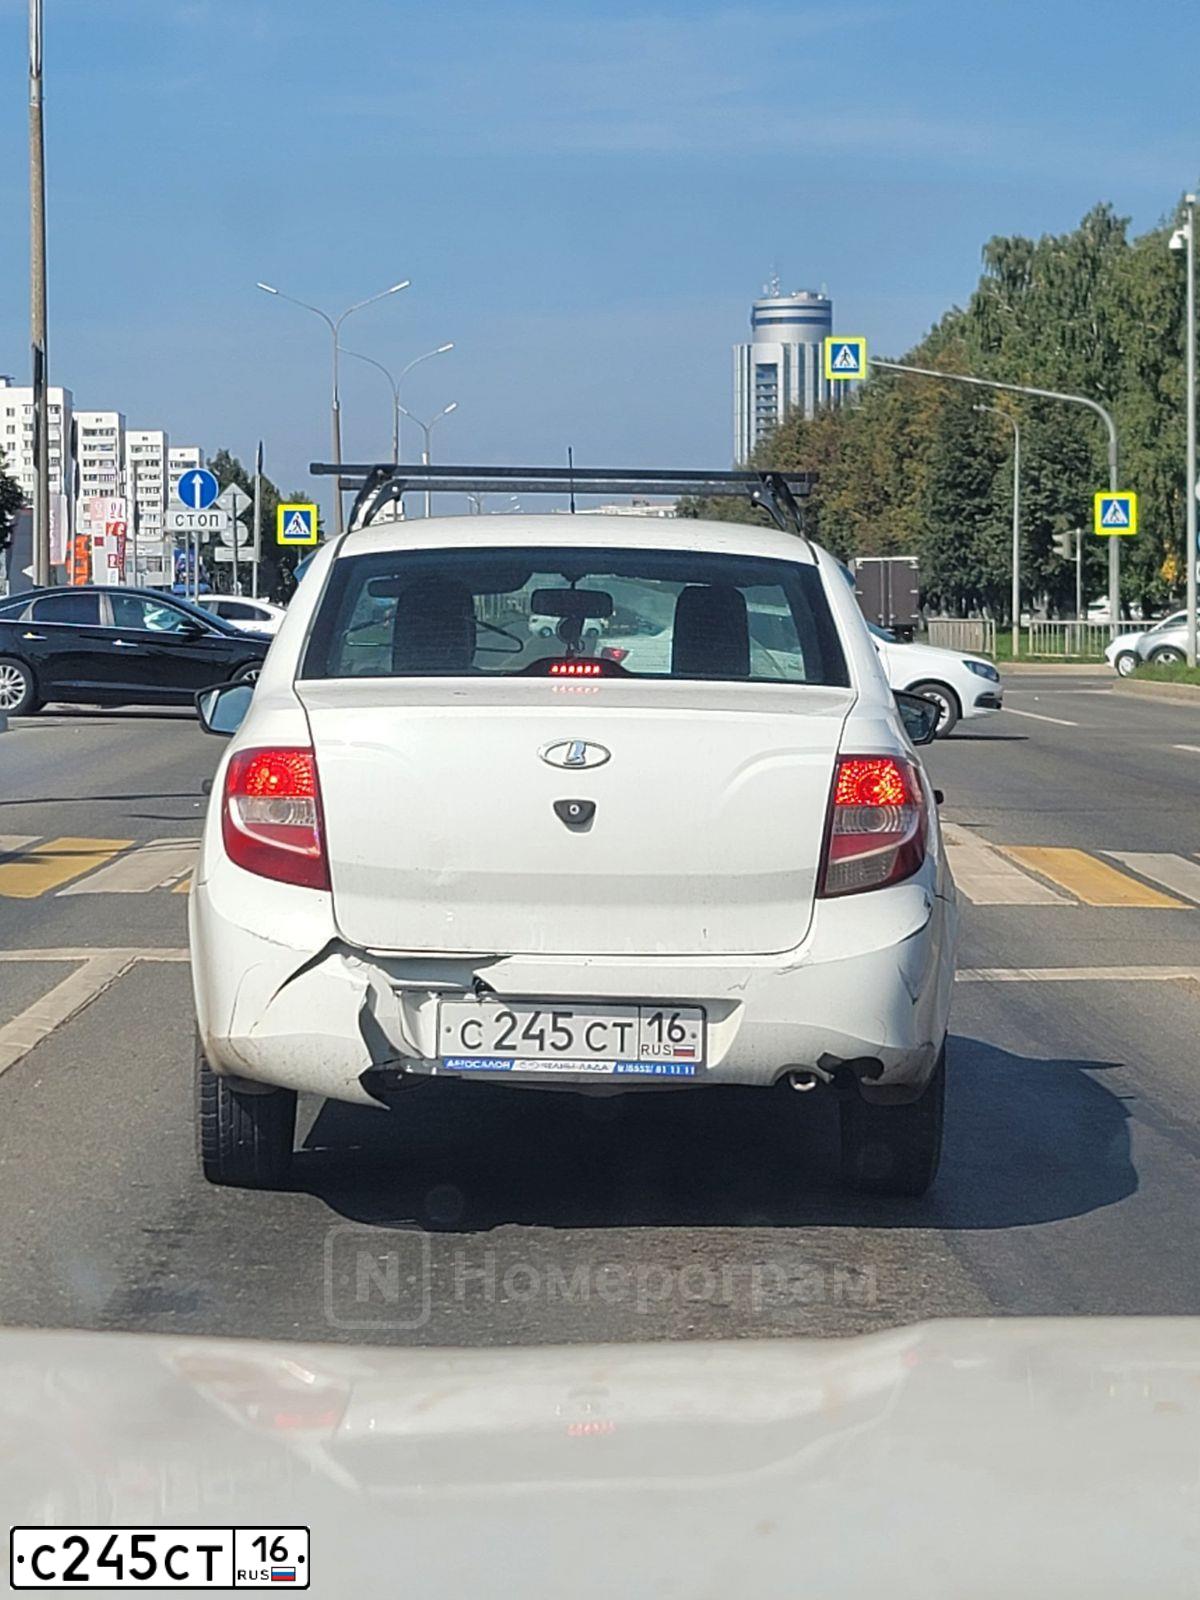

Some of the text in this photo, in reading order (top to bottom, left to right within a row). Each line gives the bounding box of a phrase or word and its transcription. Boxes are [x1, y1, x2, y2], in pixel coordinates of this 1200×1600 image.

[174, 513, 220, 528] СТОП
[646, 1012, 686, 1043] 16
[640, 1043, 672, 1056] RUS
